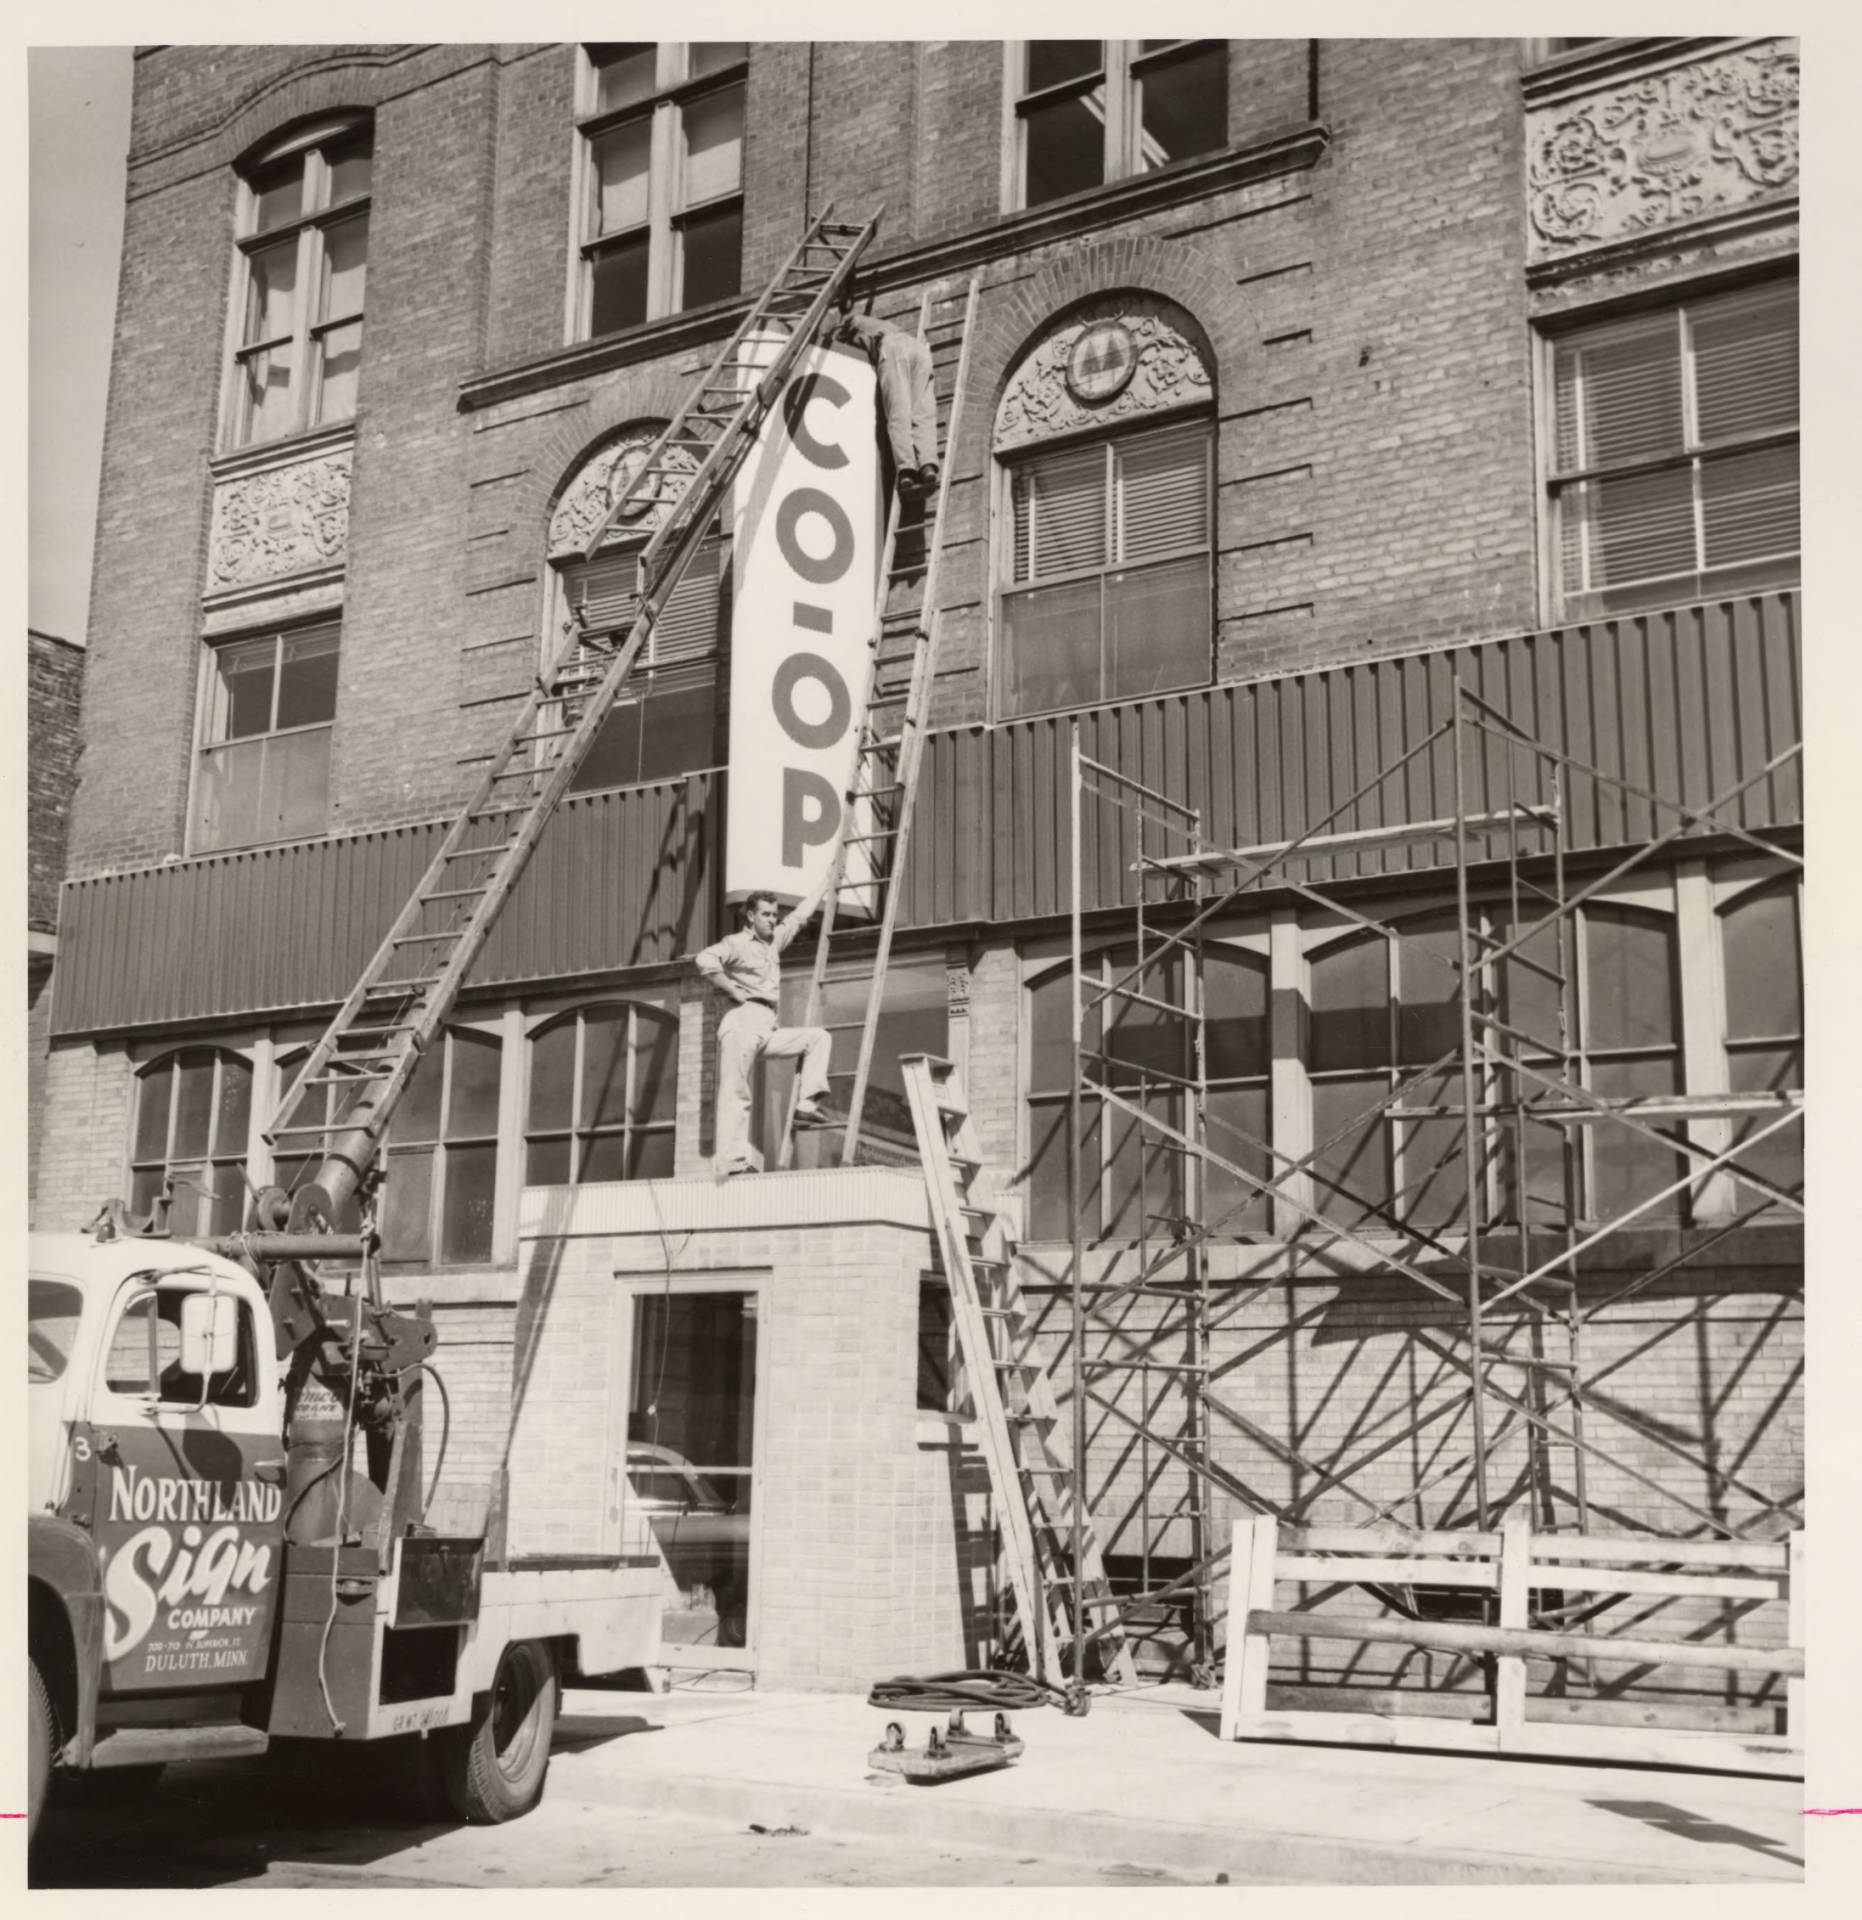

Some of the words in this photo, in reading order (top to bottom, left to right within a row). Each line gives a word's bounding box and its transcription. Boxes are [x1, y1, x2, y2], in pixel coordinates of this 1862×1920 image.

[771, 372, 856, 869] CO-OP
[74, 1436, 92, 1462] 3
[108, 1464, 282, 1523] NORTHLAND
[105, 1525, 271, 1662] Sign
[167, 1607, 257, 1630] COMPANY
